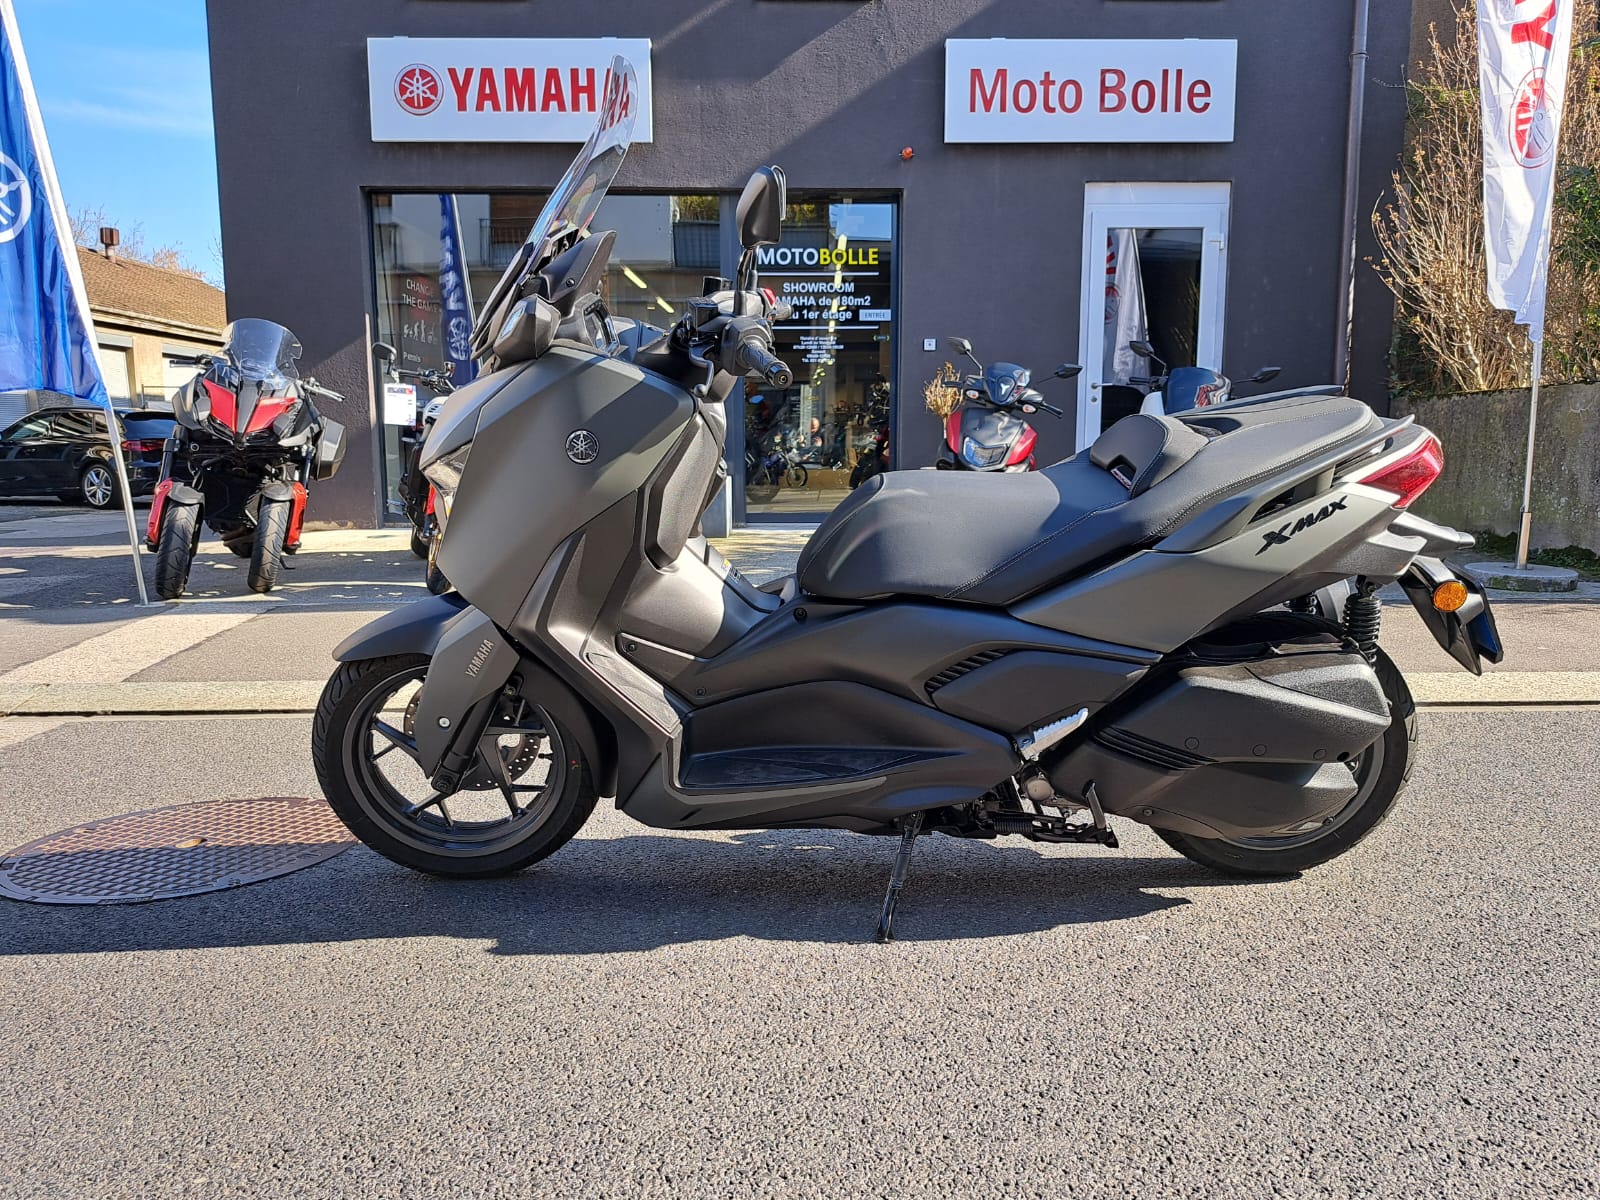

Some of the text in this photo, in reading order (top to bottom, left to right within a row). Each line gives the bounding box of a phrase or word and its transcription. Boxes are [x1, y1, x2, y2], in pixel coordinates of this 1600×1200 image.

[969, 68, 1211, 114] Moto Bolle
[783, 282, 854, 293] SHOWROOM
[402, 293, 416, 307] THE
[775, 295, 871, 306] AMAHA de 180m2
[802, 309, 820, 319] 1er
[822, 309, 852, 322] étage
[465, 639, 494, 677] YAMAHA
